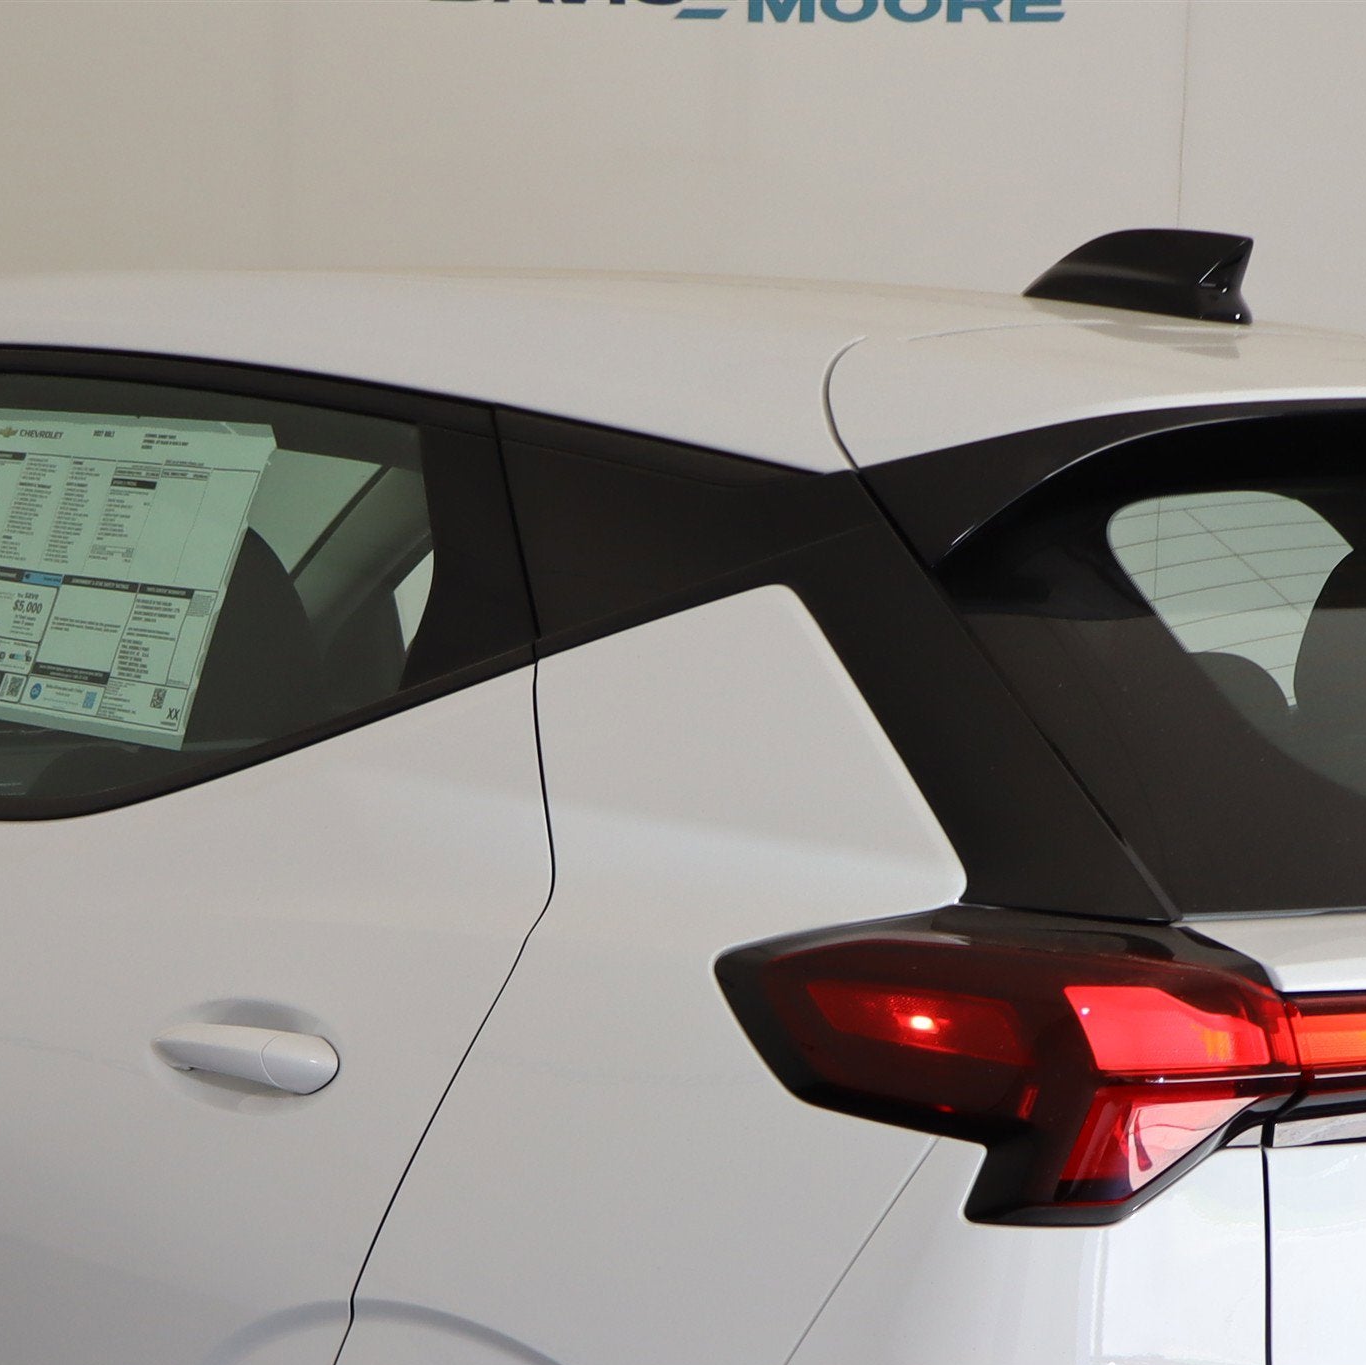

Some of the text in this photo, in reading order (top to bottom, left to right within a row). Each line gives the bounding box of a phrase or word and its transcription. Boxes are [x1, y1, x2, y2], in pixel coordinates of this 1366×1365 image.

[19, 428, 64, 439] CHEVROLET
[13, 600, 43, 614] $5,000
[167, 707, 180, 720] XX
